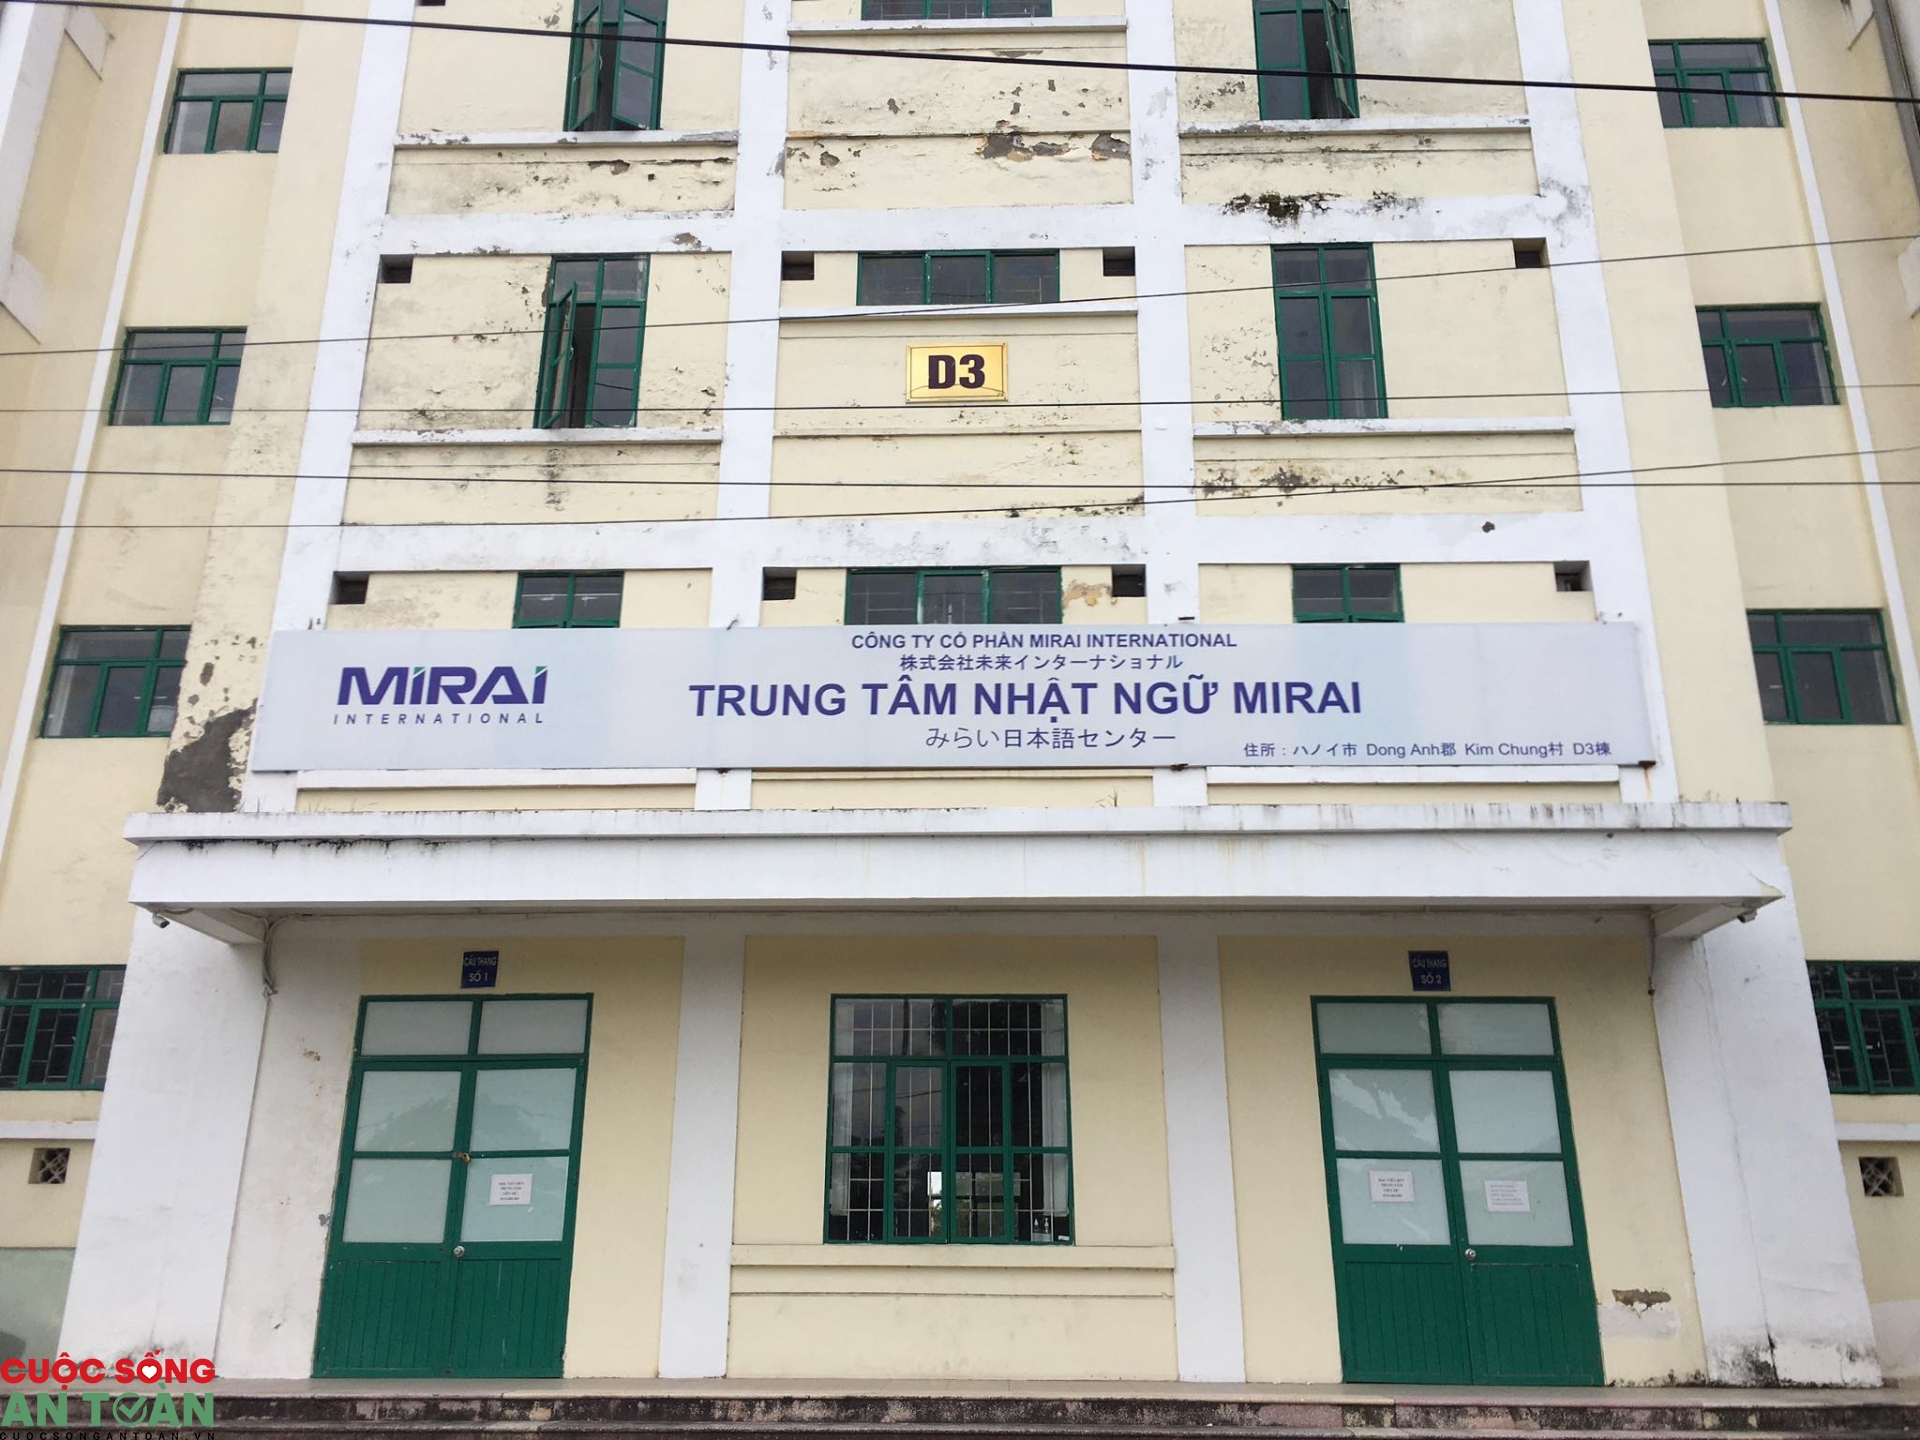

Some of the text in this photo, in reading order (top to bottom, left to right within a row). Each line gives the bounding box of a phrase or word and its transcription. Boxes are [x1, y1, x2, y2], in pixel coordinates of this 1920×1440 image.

[928, 353, 985, 389] D3
[852, 631, 906, 649] CÔNG
[912, 634, 935, 648] TY
[1030, 634, 1081, 647] MIRAI
[1087, 634, 1237, 648] INTERNATIONAL
[900, 654, 1183, 671] 株式会社未来インターナショナル
[338, 665, 548, 705] MIRAI
[689, 674, 1361, 723] TRUNG TÂM NHẬT NGỮ MIRAI
[333, 713, 543, 725] INTERNATIONAL
[925, 727, 1176, 749] みらい日本語センター
[1366, 743, 1406, 758] Dong
[1464, 743, 1494, 756] Kim
